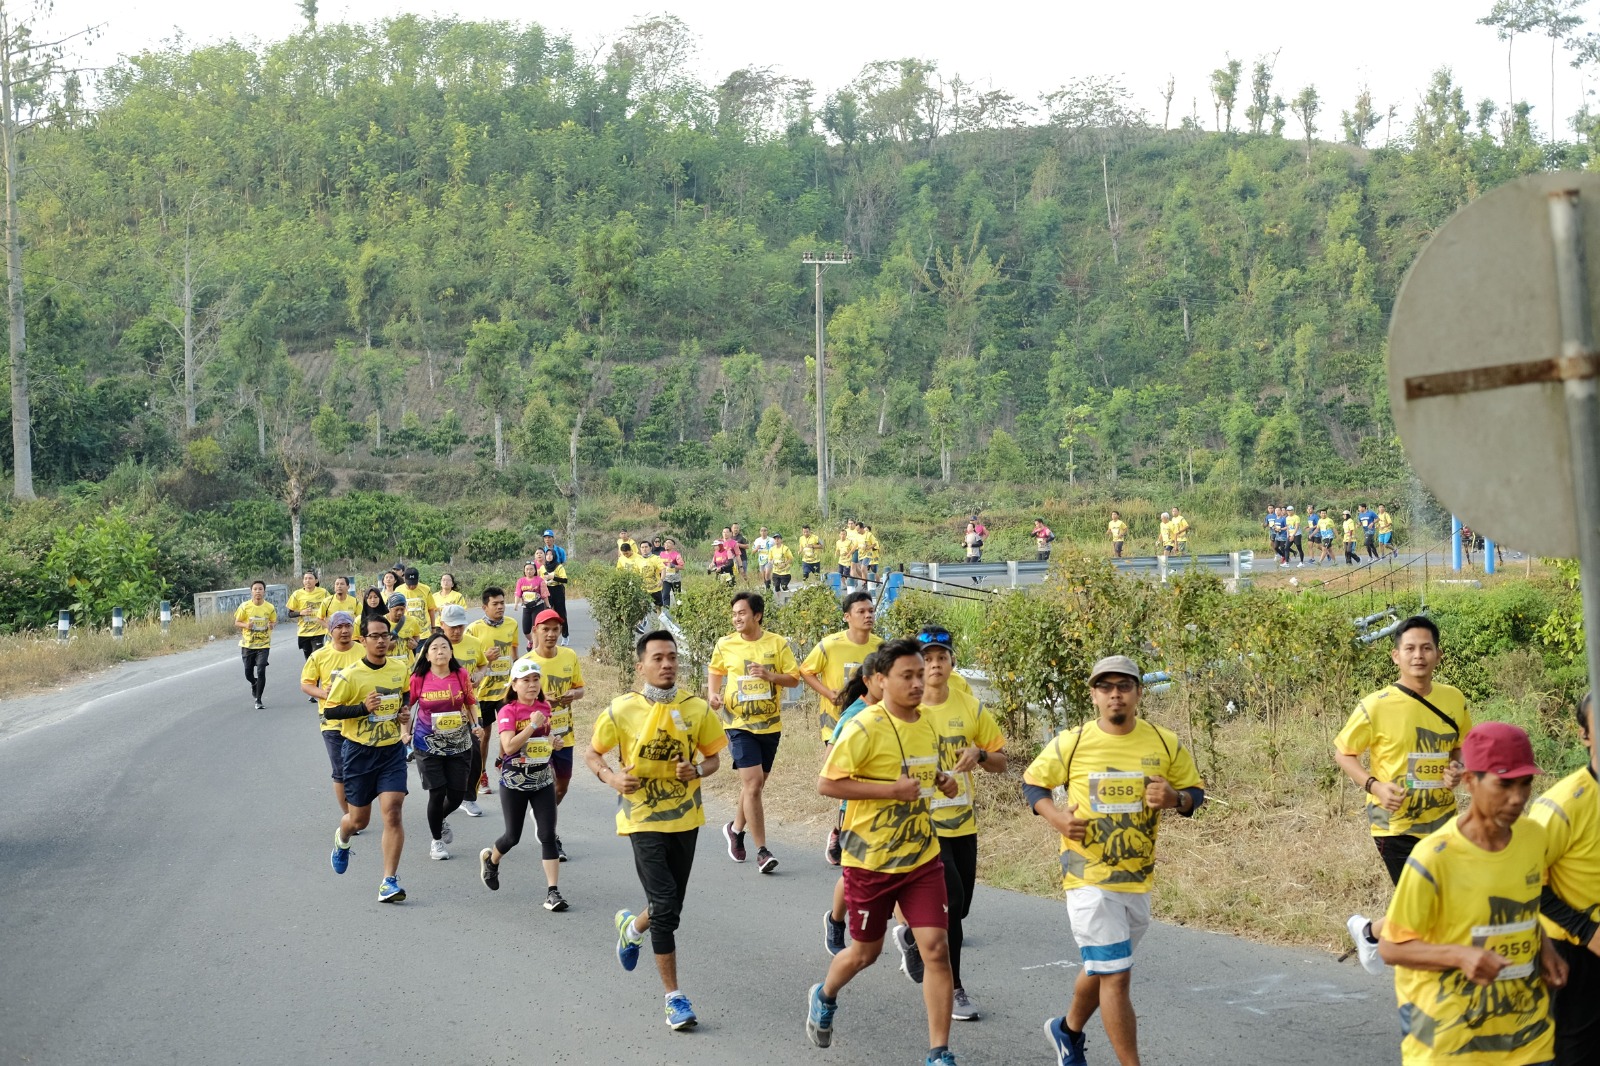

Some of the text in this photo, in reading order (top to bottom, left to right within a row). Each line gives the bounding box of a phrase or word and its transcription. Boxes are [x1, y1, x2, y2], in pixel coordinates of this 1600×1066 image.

[742, 683, 765, 691] 4340
[527, 745, 548, 753] 4266
[1415, 764, 1446, 775] 4389
[1098, 785, 1134, 797] 4358
[857, 909, 869, 930] 7
